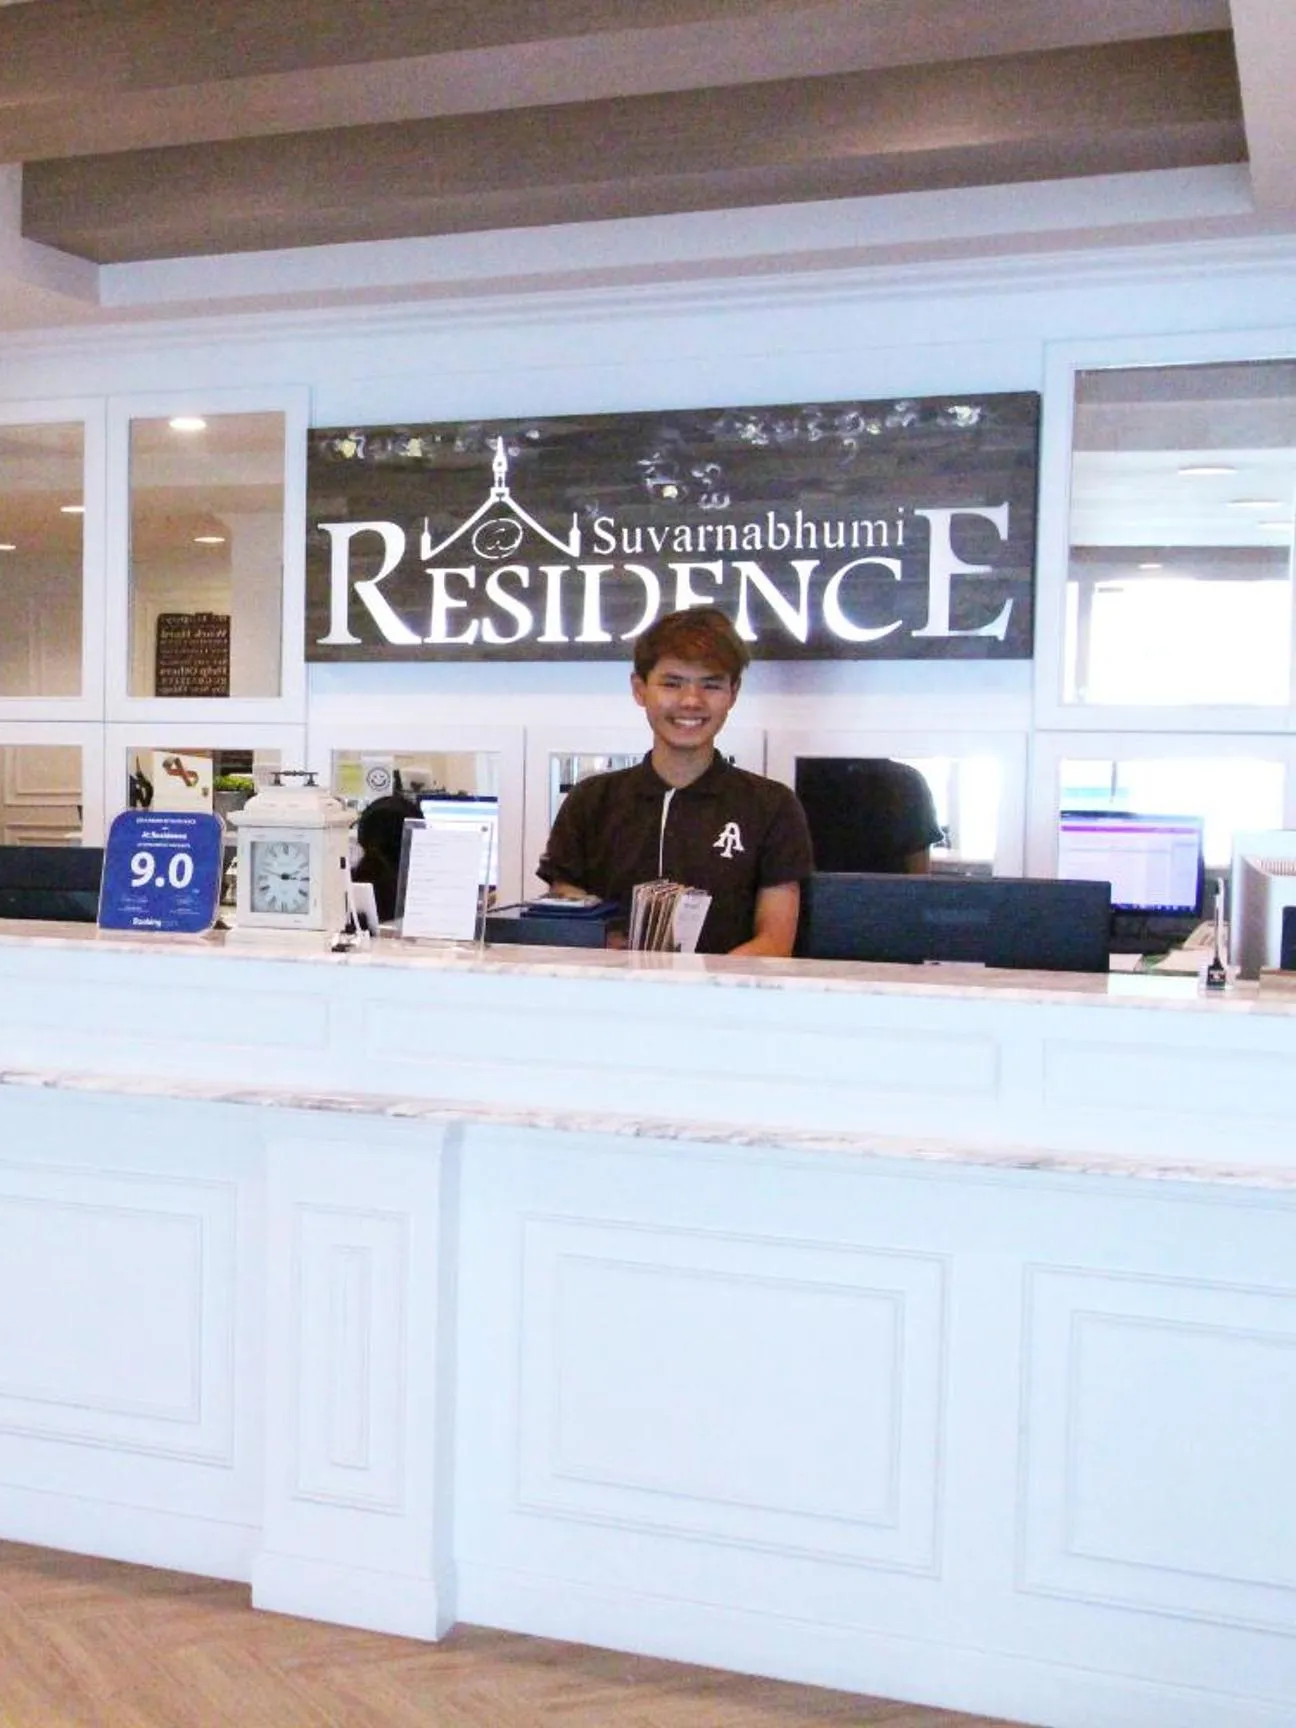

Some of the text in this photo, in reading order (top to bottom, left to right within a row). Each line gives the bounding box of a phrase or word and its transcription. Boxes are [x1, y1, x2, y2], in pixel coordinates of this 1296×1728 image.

[592, 506, 905, 555] Suvarnabhumi
[317, 503, 1014, 645] RESIDENCE
[130, 851, 194, 889] 9.0
